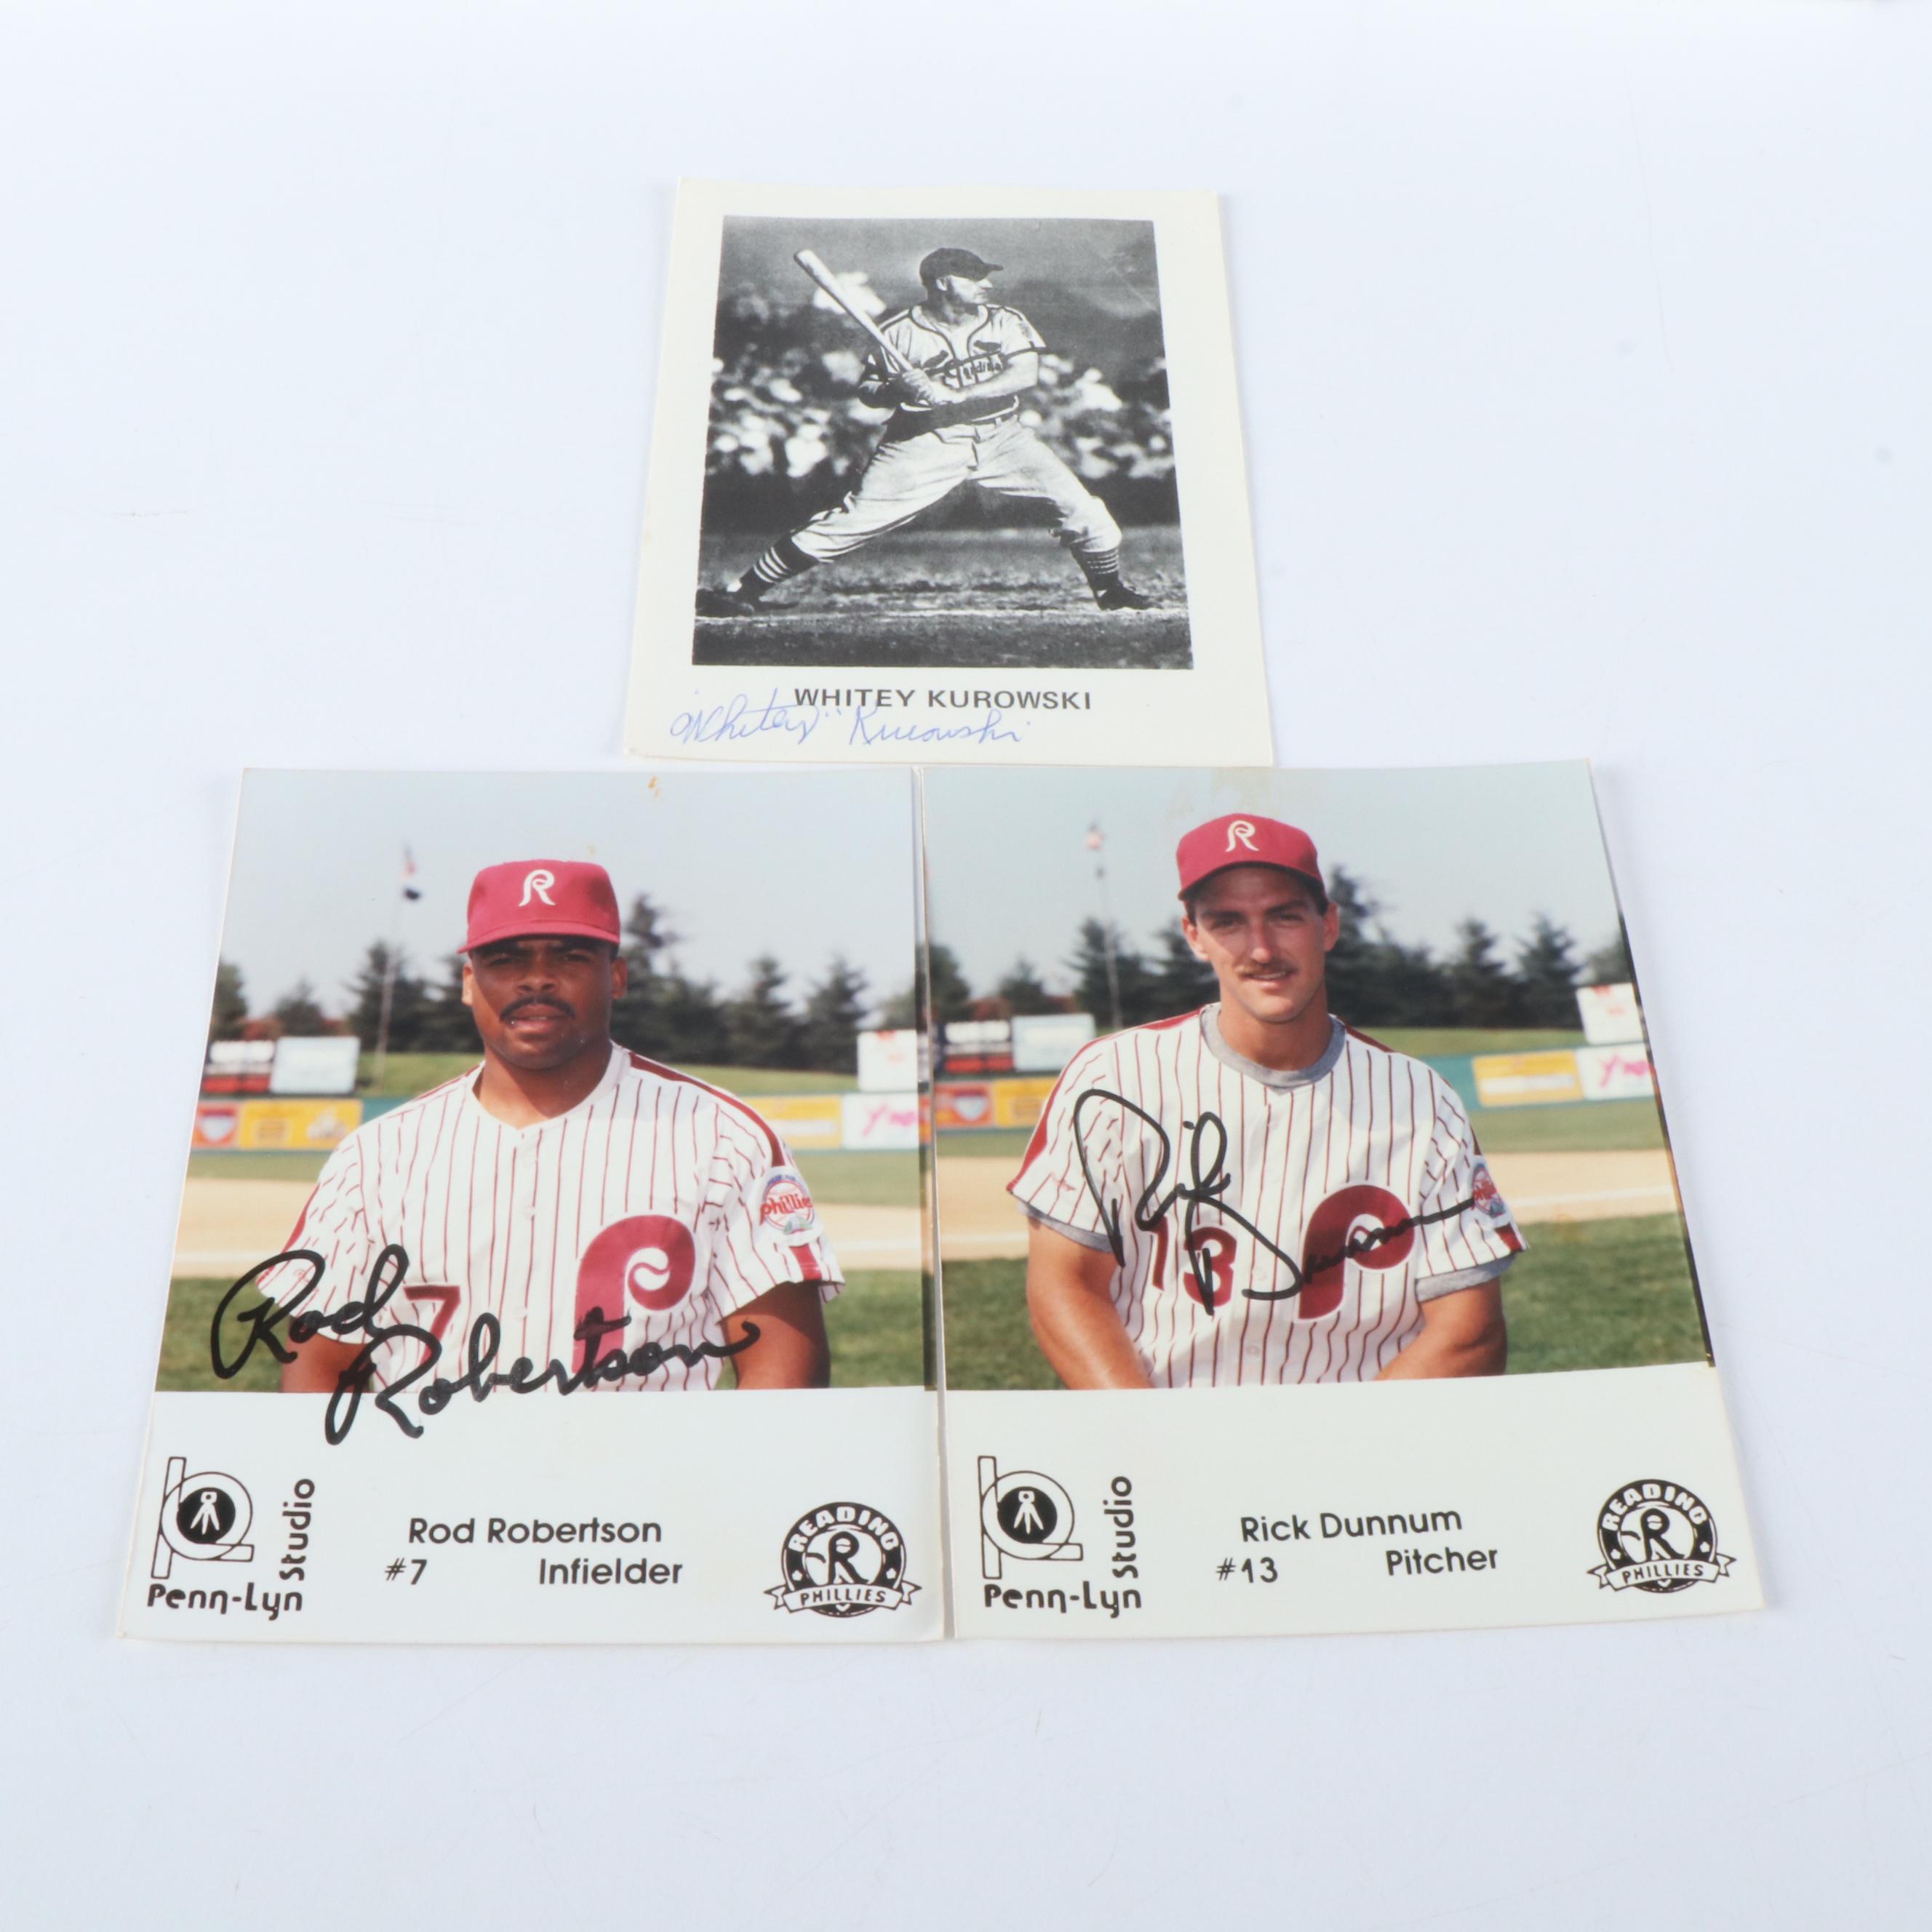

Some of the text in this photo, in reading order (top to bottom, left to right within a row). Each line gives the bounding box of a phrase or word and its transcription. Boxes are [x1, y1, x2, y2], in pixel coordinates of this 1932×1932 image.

[794, 689, 1091, 709] WHITEY KUROWSKI
[1225, 820, 1260, 853] R
[517, 869, 556, 906] R
[1151, 1216, 1237, 1308] 13
[404, 1284, 461, 1365] 7
[1602, 1482, 1708, 1532] READING
[409, 1517, 662, 1544] Rod Robertson
[788, 1506, 900, 1552] READING
[1240, 1510, 1463, 1542] Rick Dunnum
[385, 1557, 683, 1585] #7 Infielder
[1216, 1546, 1498, 1584] #13 Pitcher
[1621, 1563, 1704, 1585] PHILLIES
[147, 1582, 303, 1621] Penn-Lyn
[799, 1588, 887, 1606] PHILLIES
[983, 1581, 1141, 1618] Penn-Lyn
